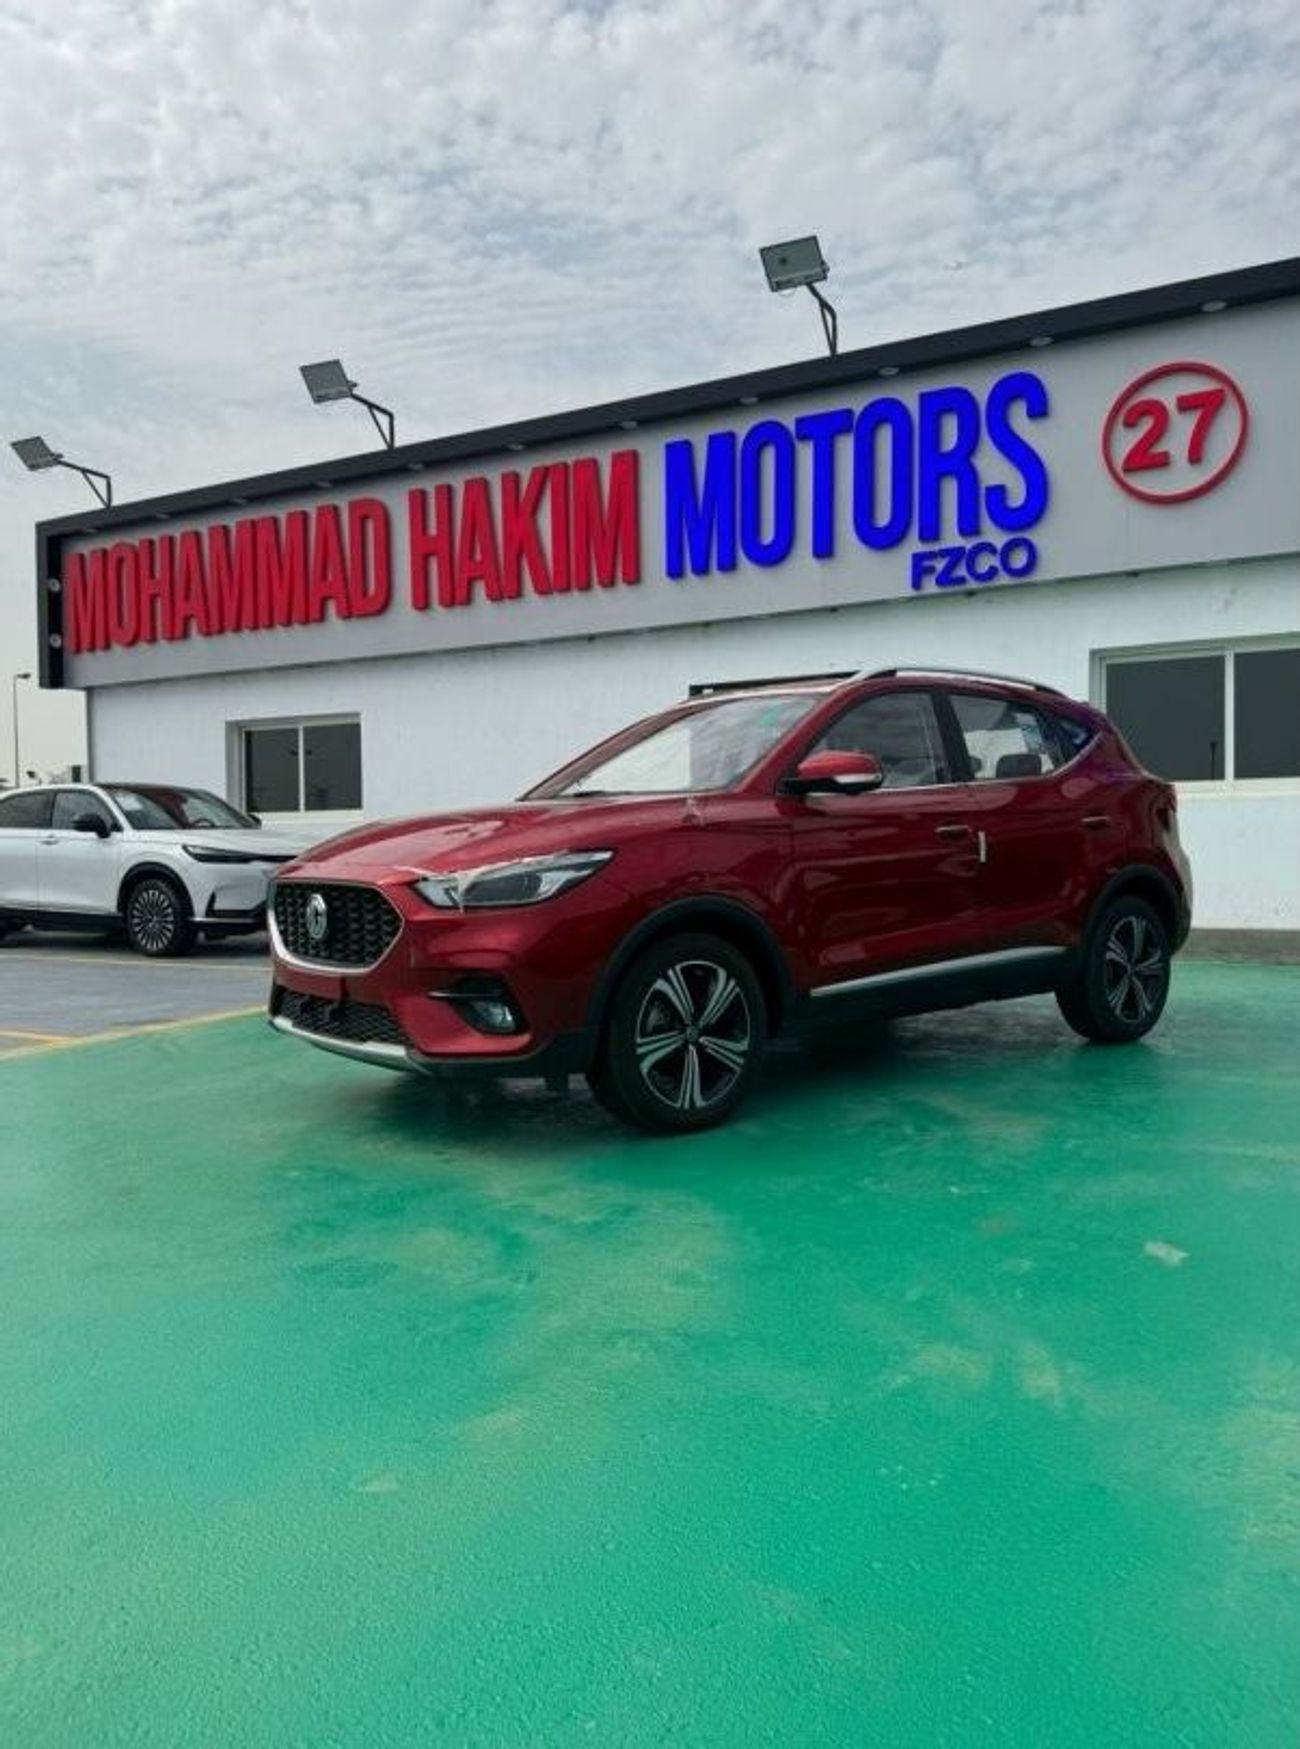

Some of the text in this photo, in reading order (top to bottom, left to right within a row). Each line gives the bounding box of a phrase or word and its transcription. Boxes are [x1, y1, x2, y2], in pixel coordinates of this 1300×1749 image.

[1121, 387, 1227, 473] 27
[65, 370, 1051, 654] MOHAMMAD HAKIM MOTORS
[911, 536, 1038, 591] FZCO
